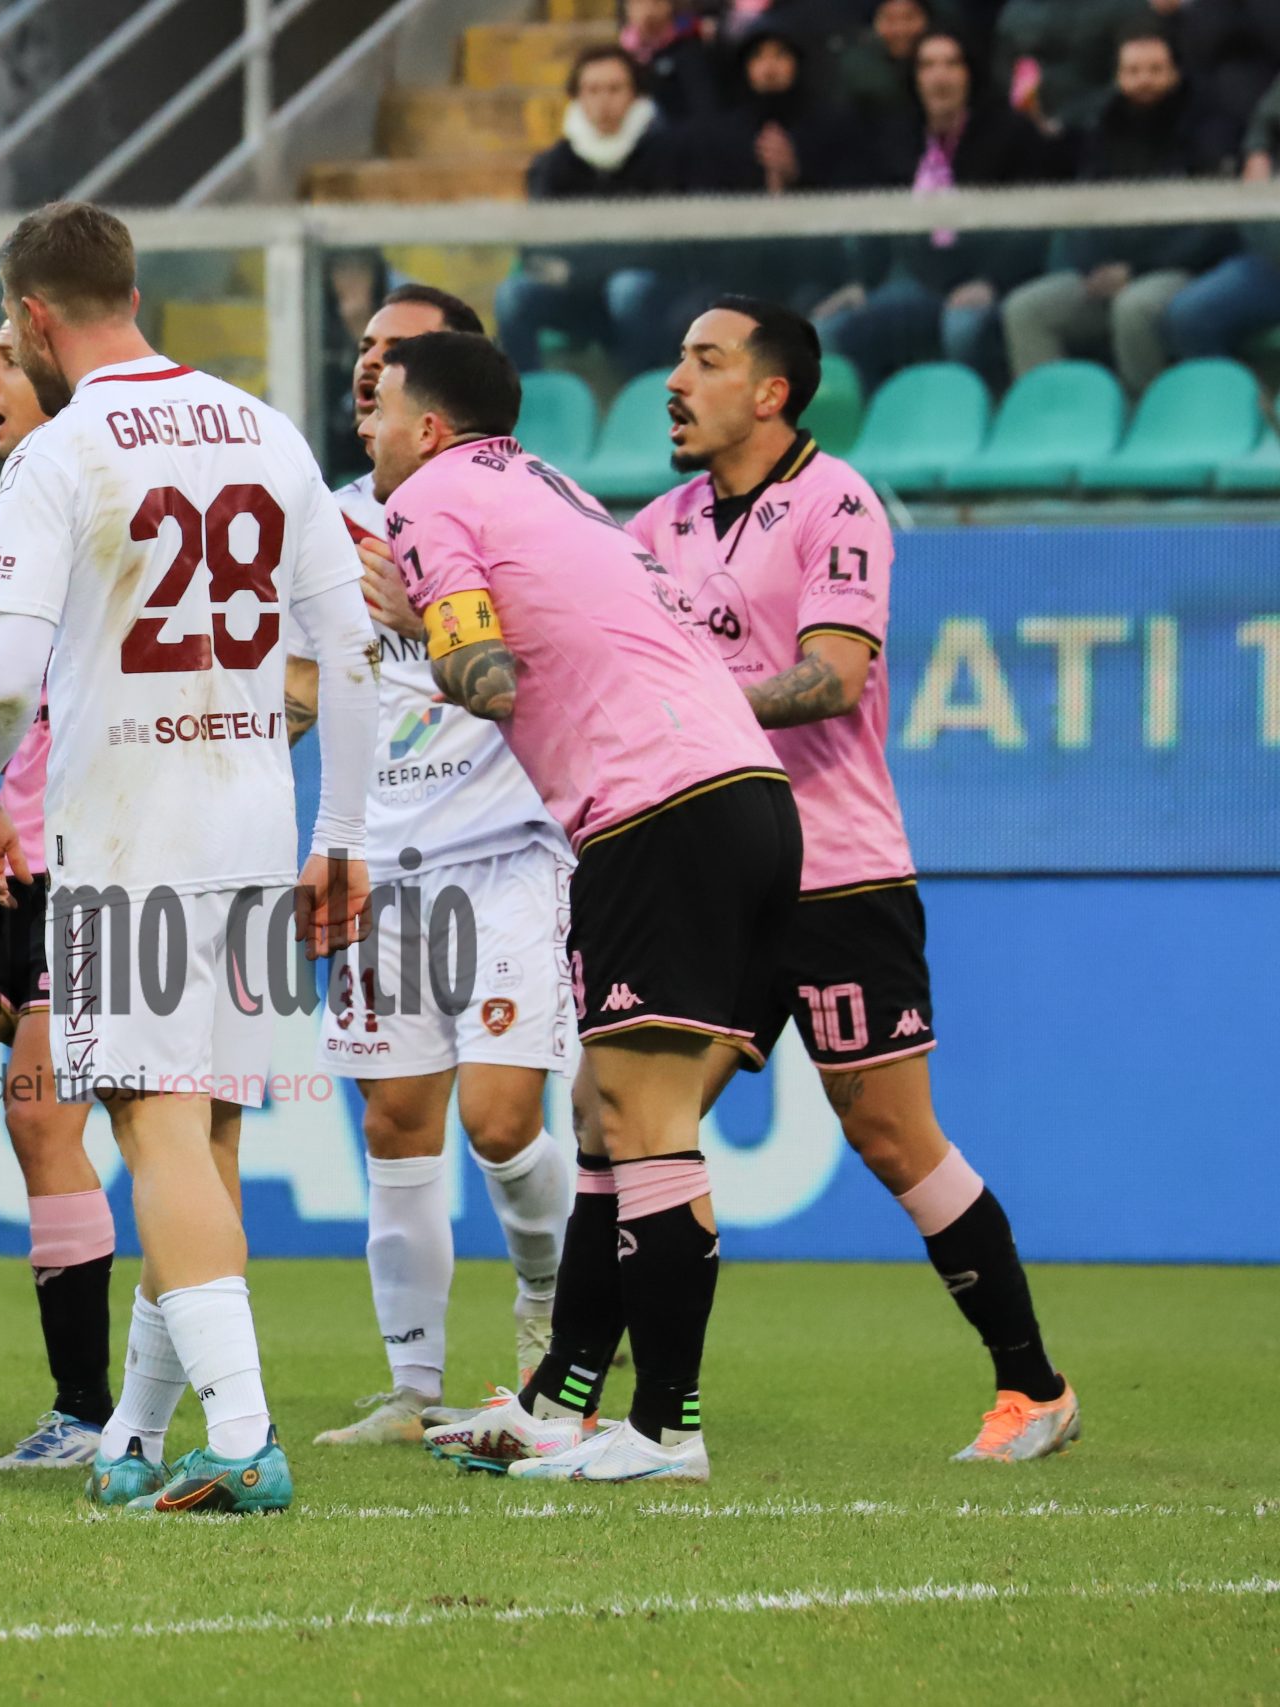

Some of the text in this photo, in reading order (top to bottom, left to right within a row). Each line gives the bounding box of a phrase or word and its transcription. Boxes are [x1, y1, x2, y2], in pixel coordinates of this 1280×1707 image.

[106, 403, 261, 449] GAGLIOLO
[121, 484, 286, 674] 28
[378, 760, 472, 787] FERRARO
[798, 983, 870, 1052] 10
[327, 1038, 391, 1055] GIVOVA
